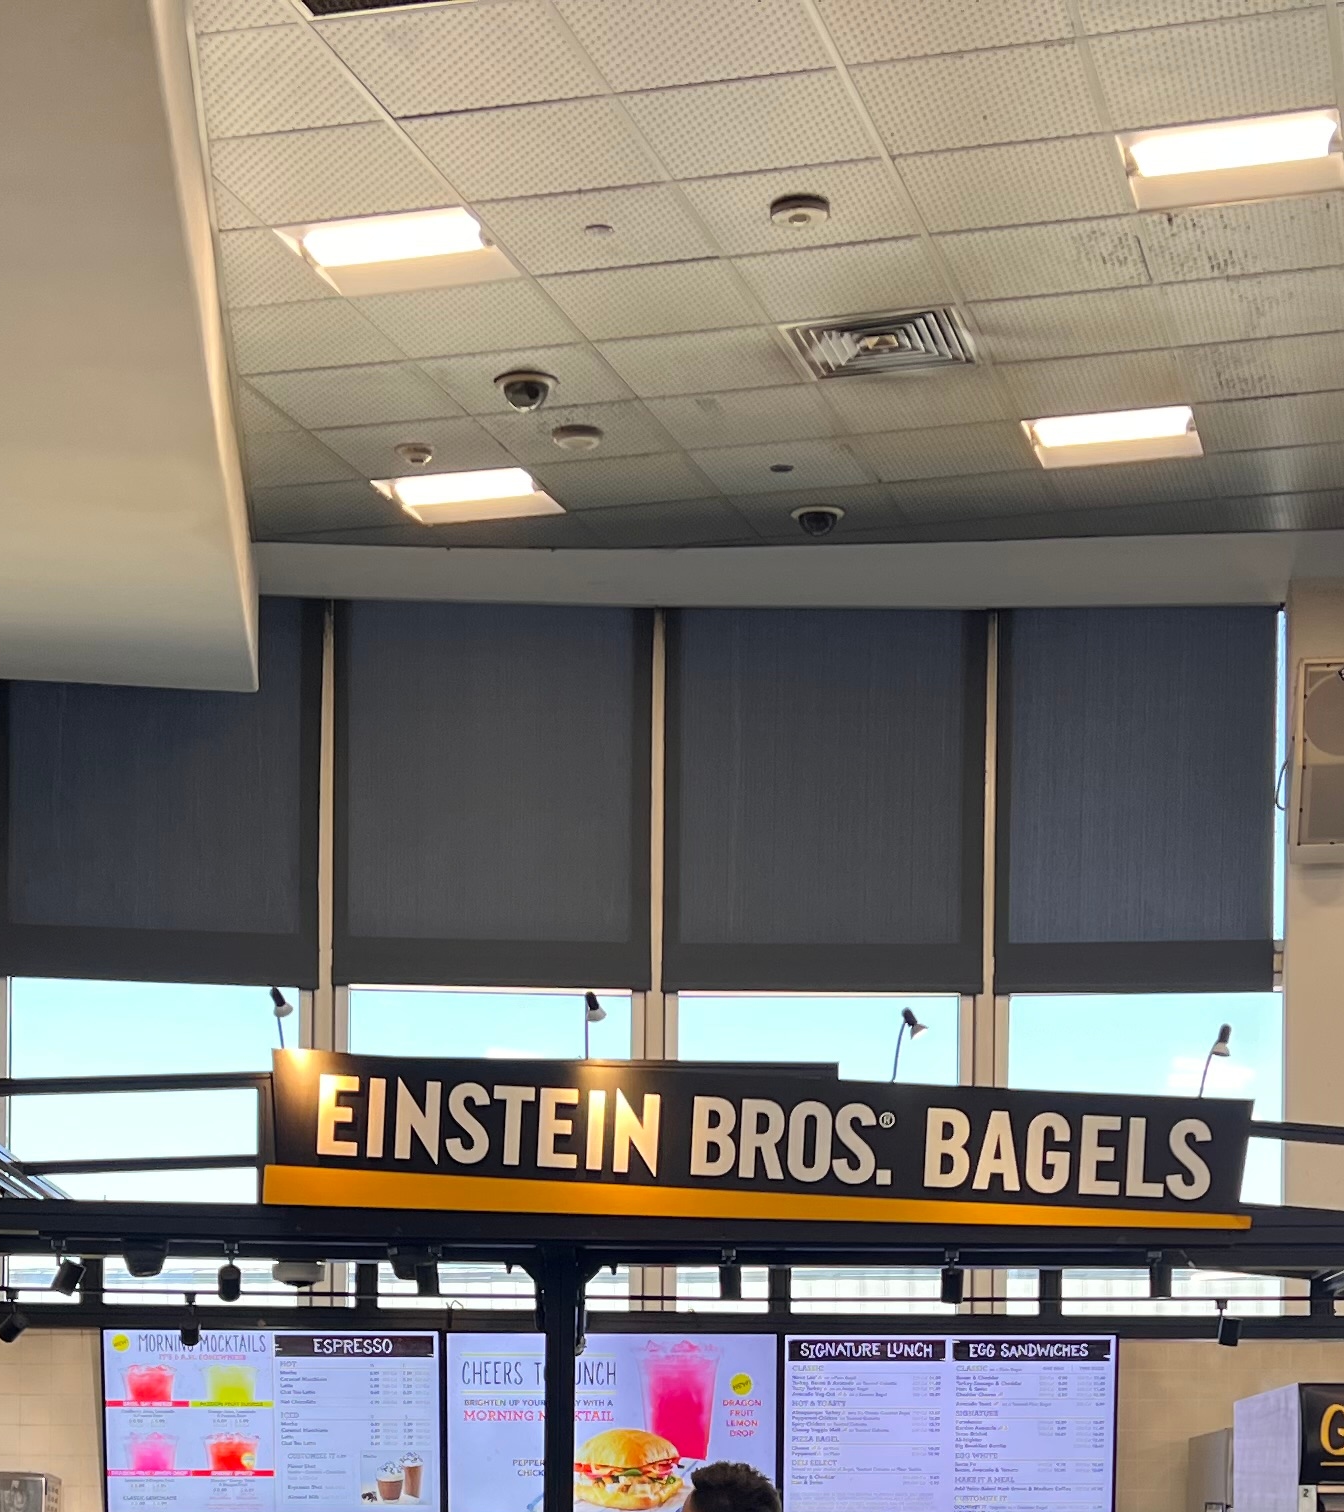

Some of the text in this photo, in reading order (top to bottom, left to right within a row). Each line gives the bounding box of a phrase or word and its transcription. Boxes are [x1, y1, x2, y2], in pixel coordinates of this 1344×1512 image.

[316, 1075, 660, 1178] EINSTEIN
[923, 1107, 1212, 1202] BAGELS
[138, 1334, 267, 1353] MORNIN MOCKTAILS
[312, 1338, 393, 1355] ESPRESSO
[799, 1342, 933, 1359] SIGNATURE LUNCH
[968, 1343, 1089, 1358] EGG SANDWICHES
[461, 1360, 523, 1386] CHEERS
[464, 1399, 507, 1407] BRIGHTEN
[509, 1399, 520, 1407] UP
[583, 1399, 605, 1407] WITH
[607, 1399, 614, 1407] A
[722, 1399, 762, 1407] DRAGON
[463, 1410, 534, 1422] MORNING
[729, 1409, 754, 1417] FRUIT
[725, 1419, 758, 1427] LEMON
[729, 1429, 755, 1437] DROP
